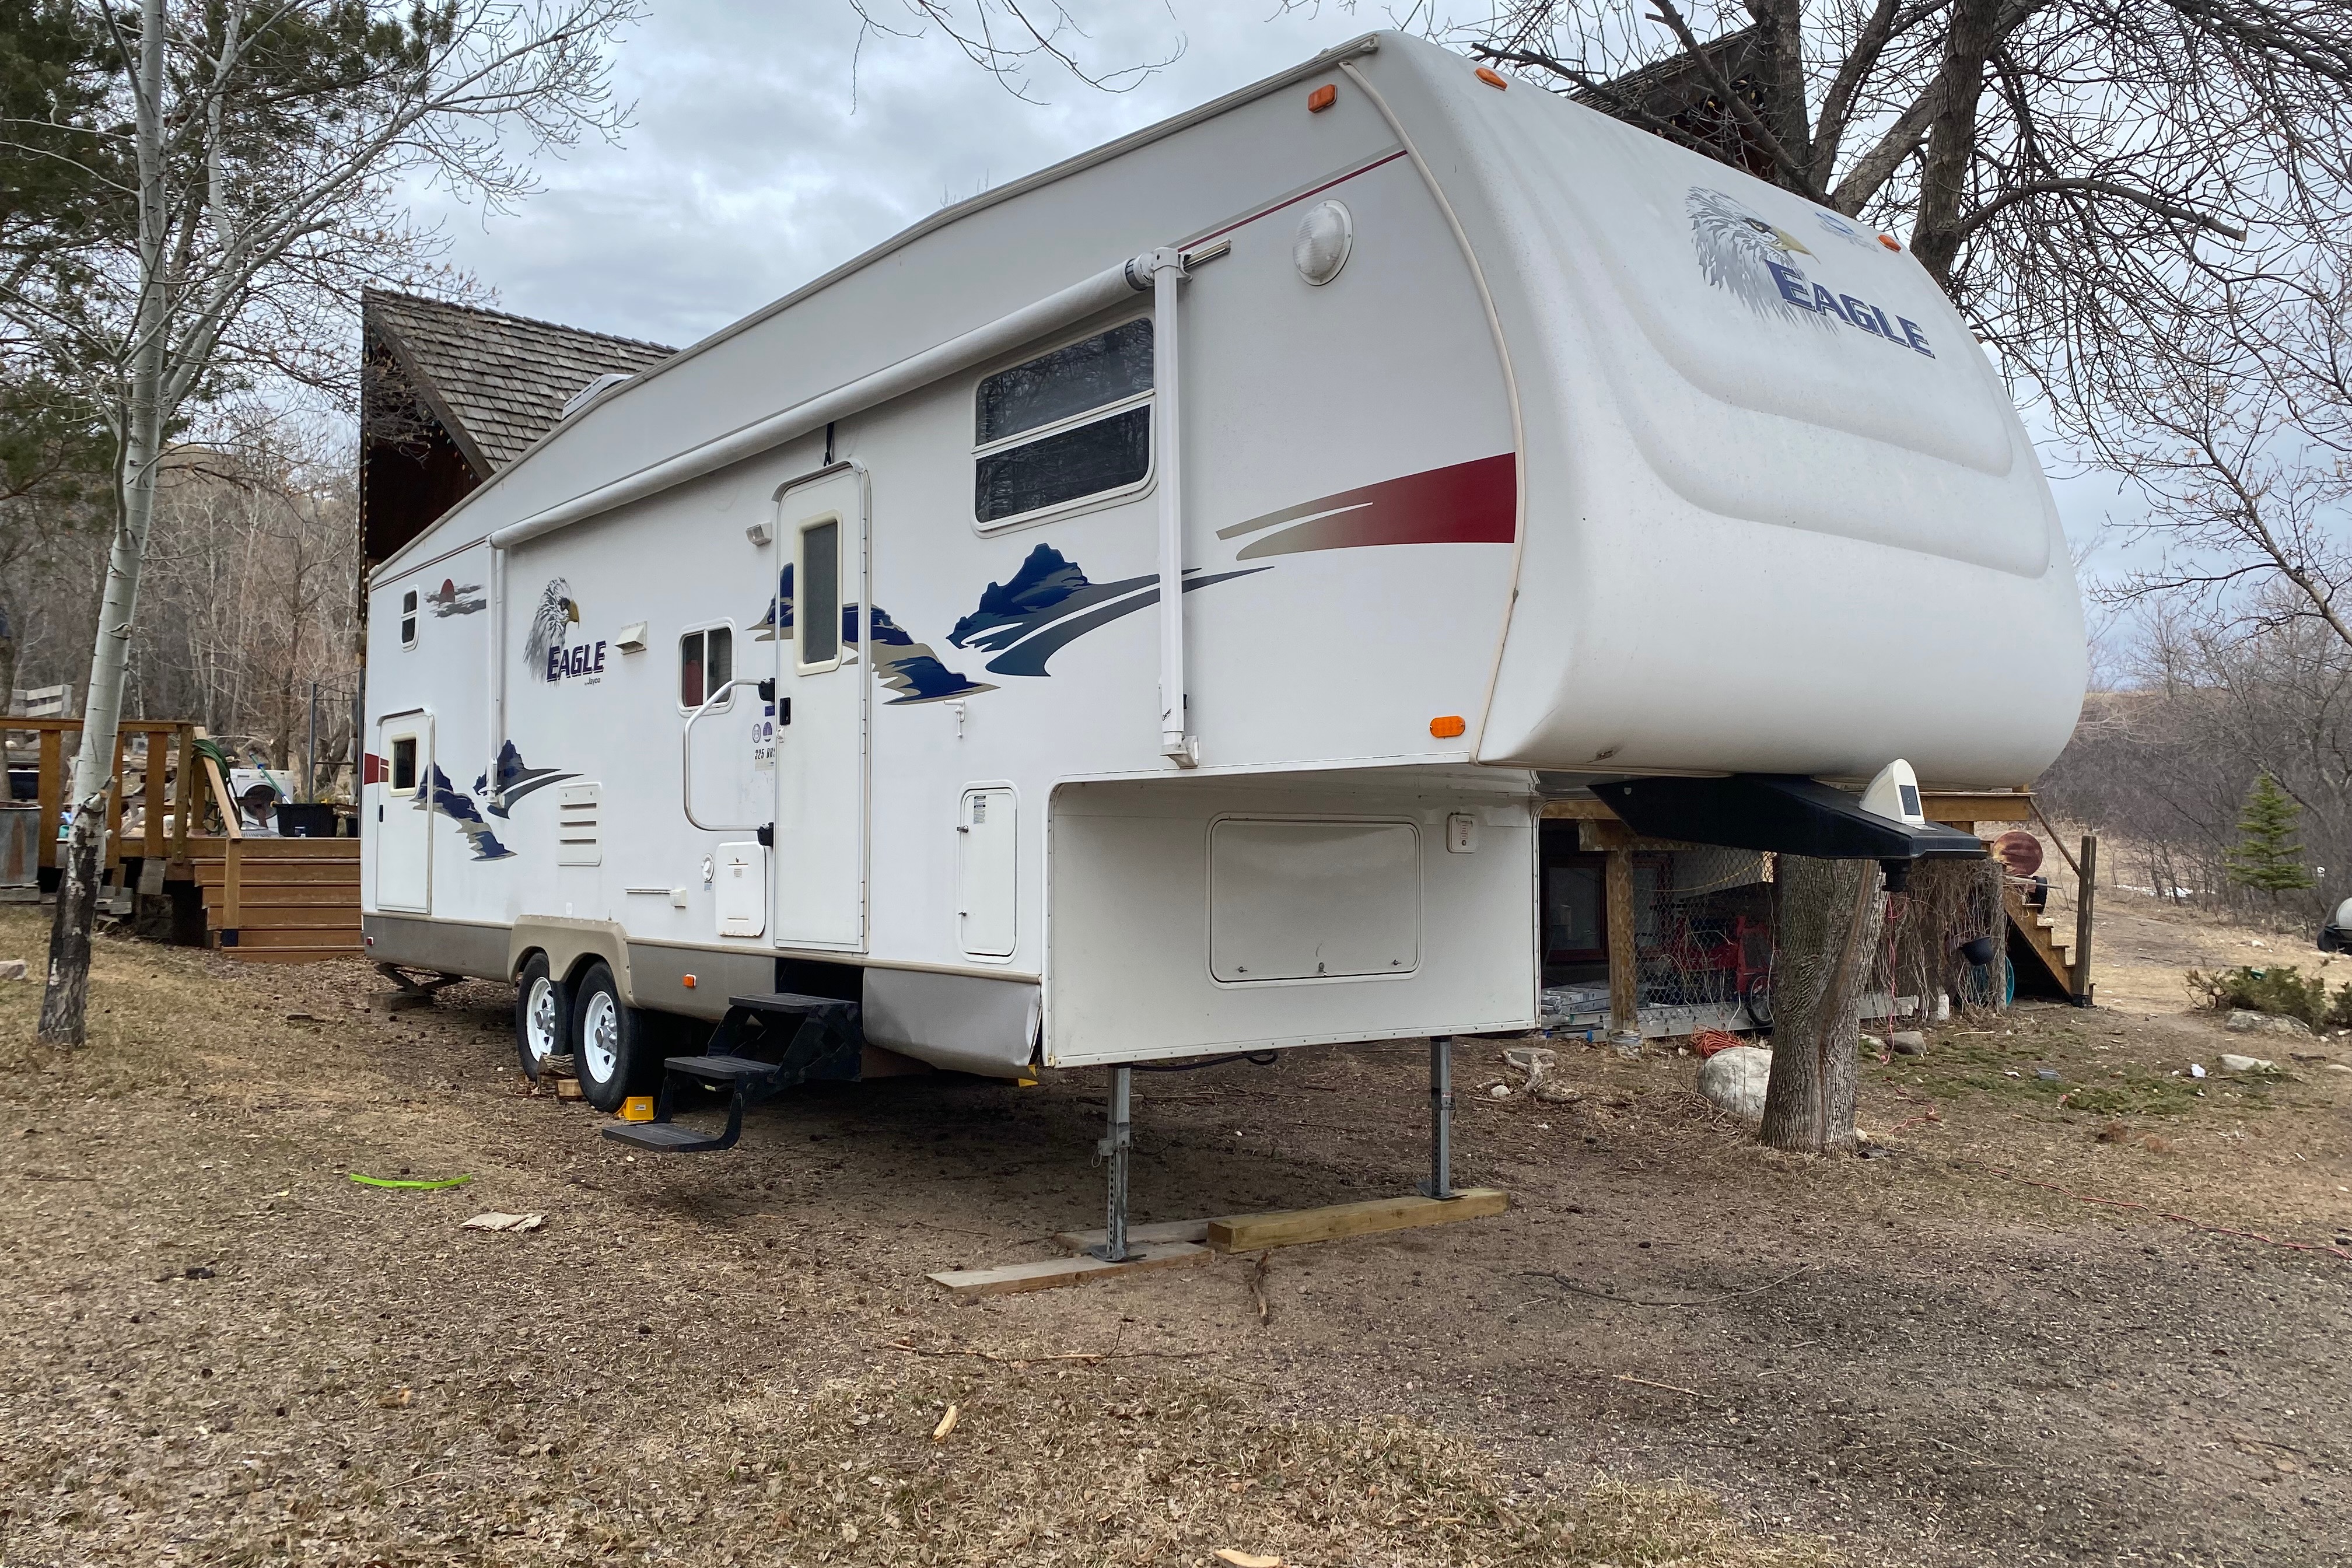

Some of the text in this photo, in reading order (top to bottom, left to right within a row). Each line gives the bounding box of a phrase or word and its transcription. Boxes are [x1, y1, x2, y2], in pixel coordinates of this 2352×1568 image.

[1763, 259, 1936, 359] EAGLE
[547, 640, 606, 682] EAGLE
[587, 677, 601, 686] Jayco
[755, 748, 764, 760] 325
